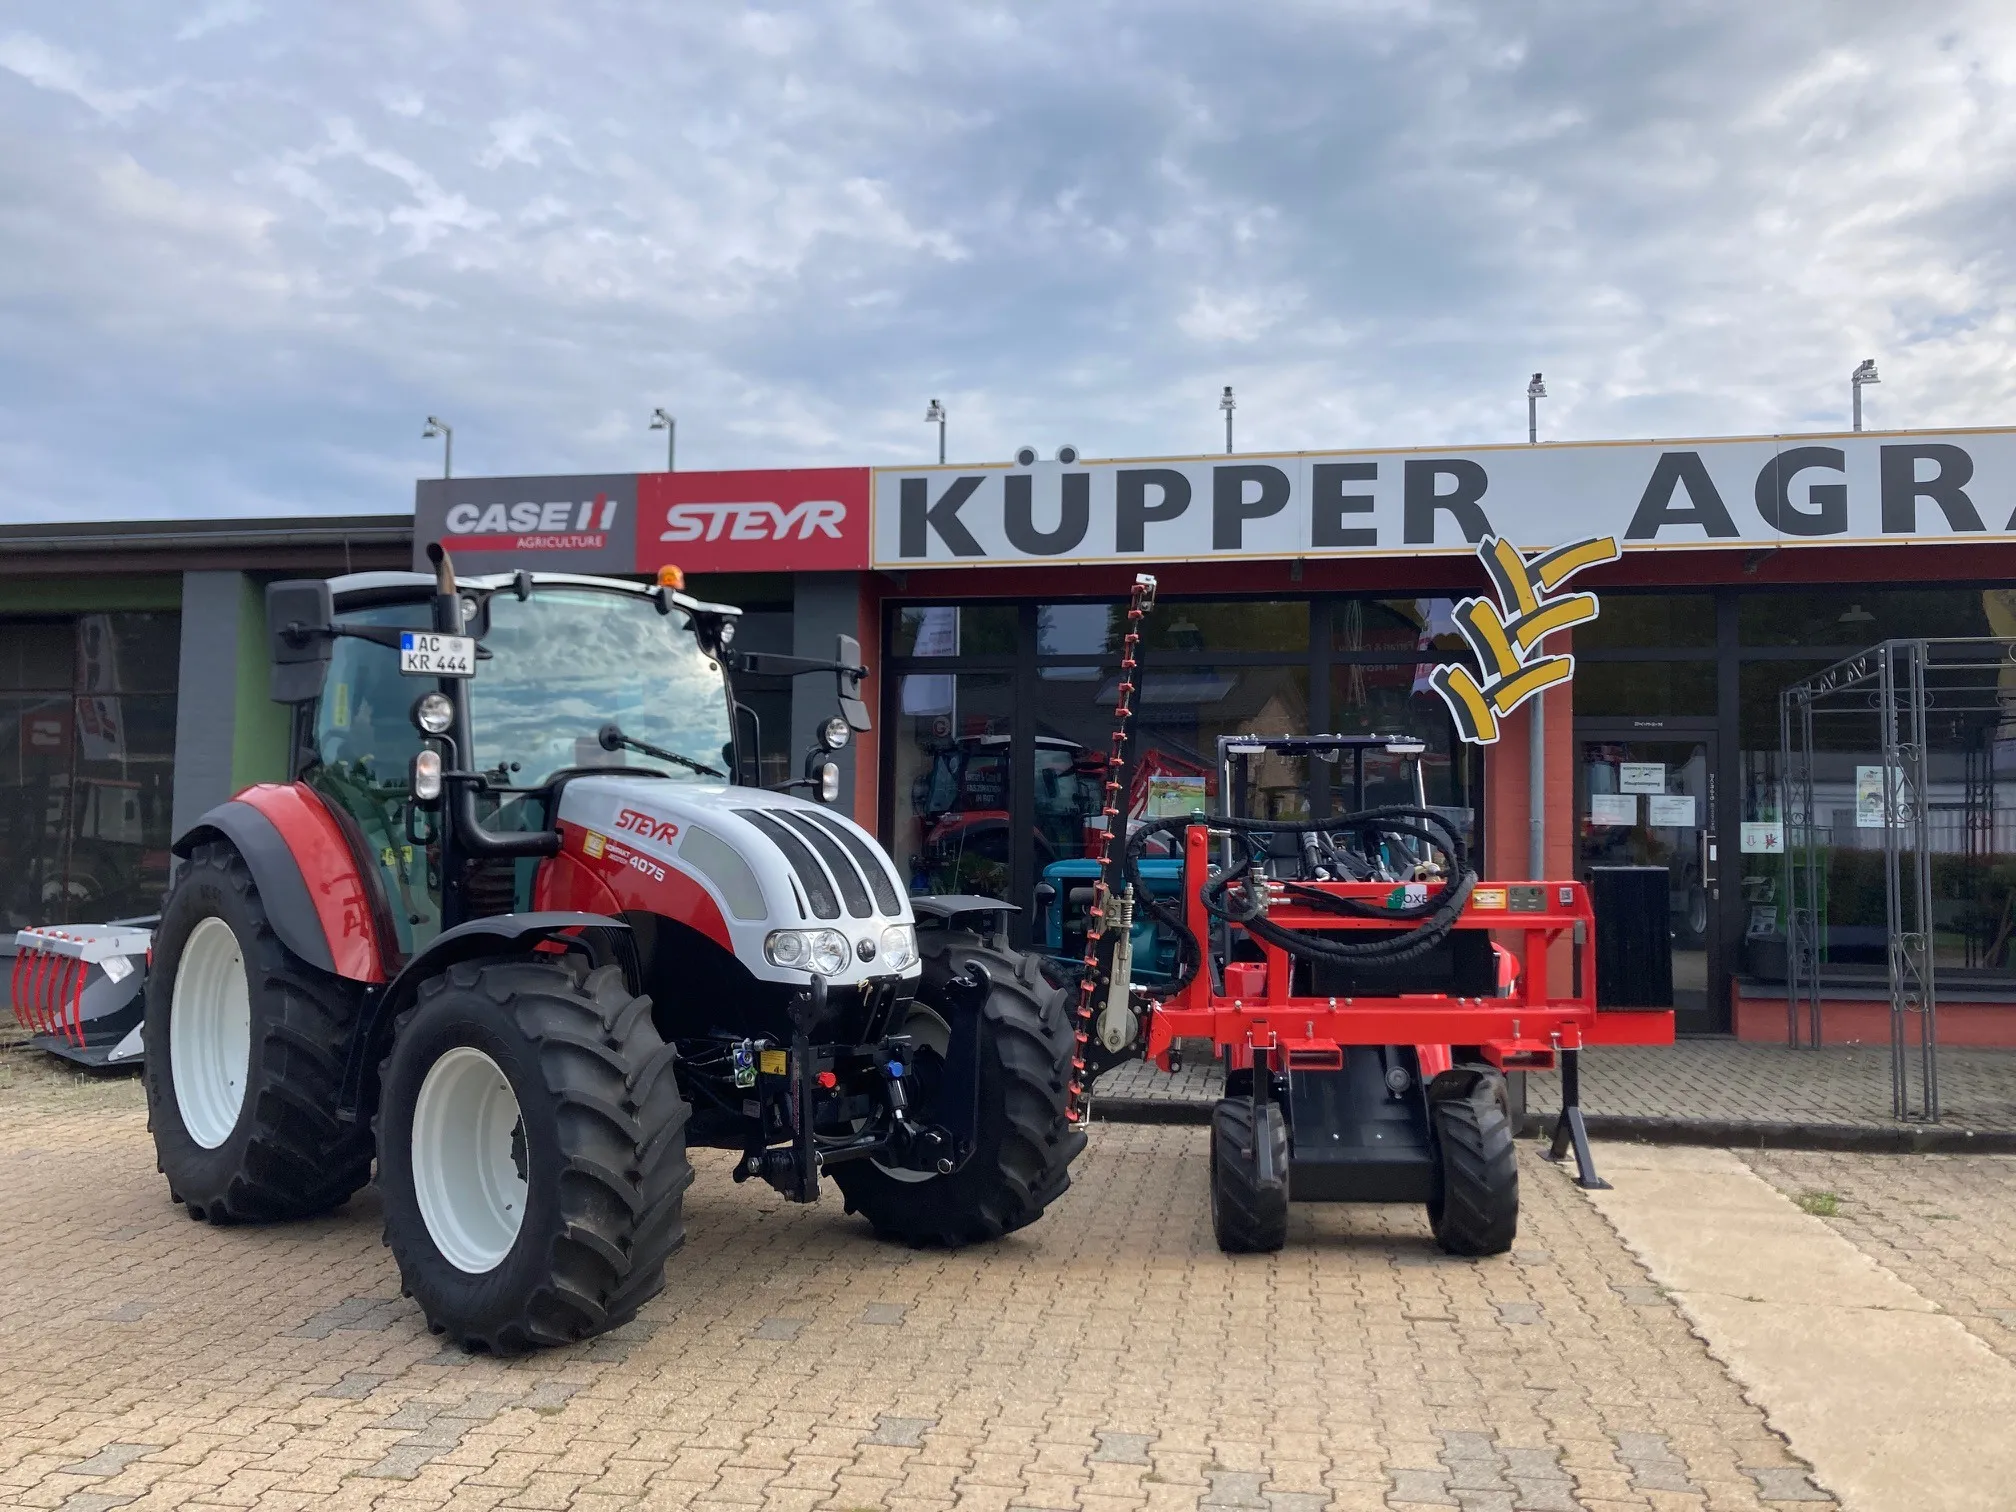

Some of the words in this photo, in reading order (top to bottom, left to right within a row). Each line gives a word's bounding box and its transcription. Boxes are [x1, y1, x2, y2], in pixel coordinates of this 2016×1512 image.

[900, 447, 1495, 558] KÜPPER
[1623, 443, 2016, 540] AGR
[446, 501, 573, 534] CASE
[659, 500, 847, 542] STEYR
[516, 535, 603, 549] AGRICULTURE
[419, 636, 440, 652] AC
[408, 654, 430, 670] KR
[436, 655, 467, 672] 444
[614, 808, 679, 846] STEYR
[629, 855, 666, 883] 4075
[1394, 893, 1429, 904] BOXE
